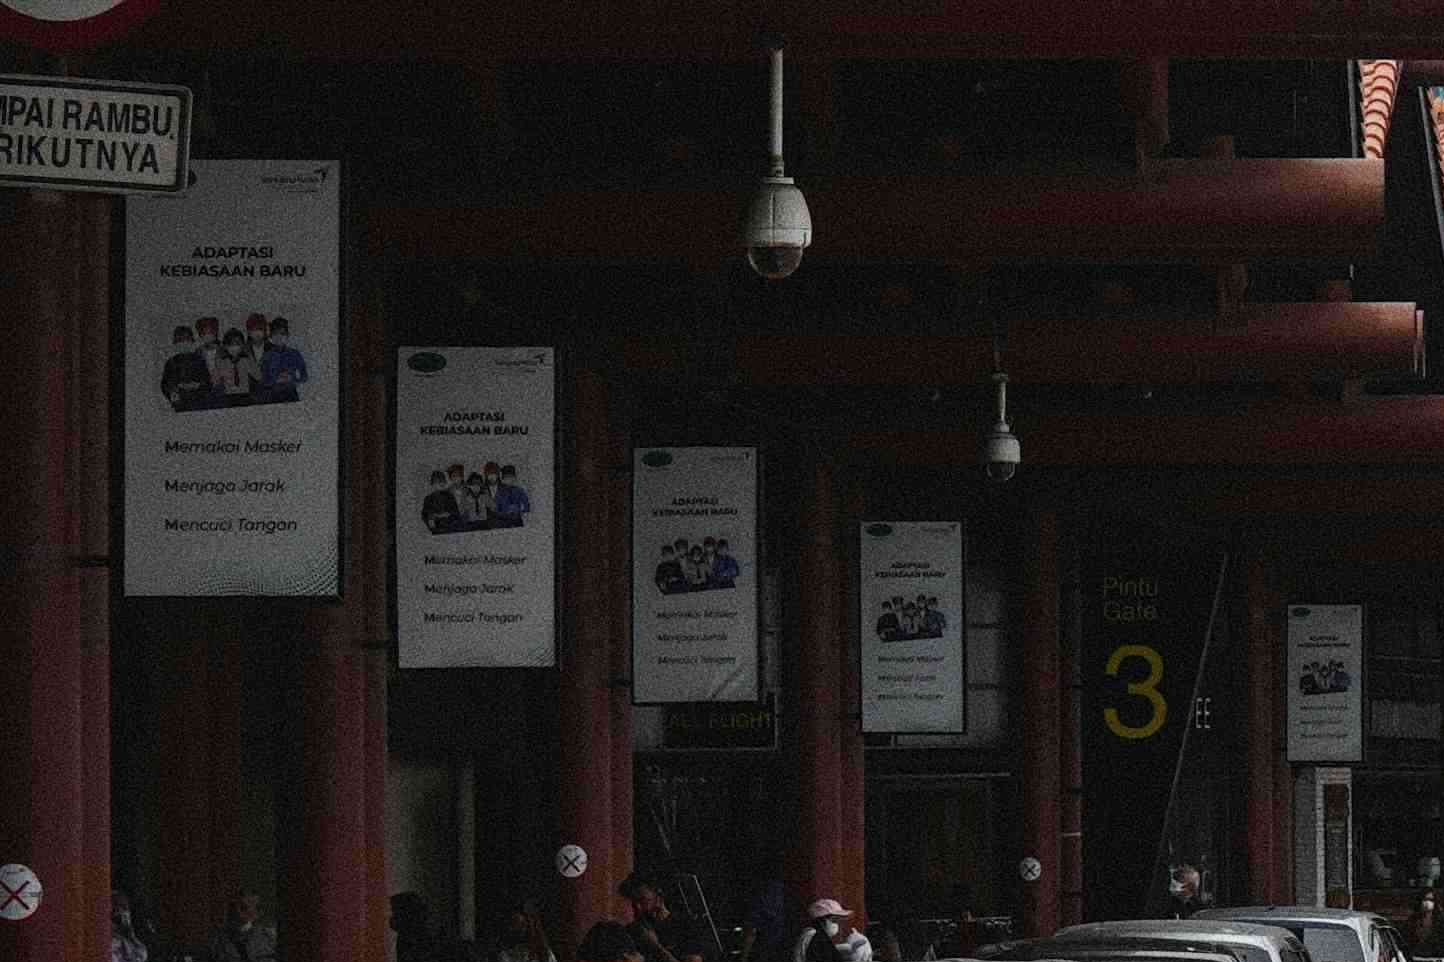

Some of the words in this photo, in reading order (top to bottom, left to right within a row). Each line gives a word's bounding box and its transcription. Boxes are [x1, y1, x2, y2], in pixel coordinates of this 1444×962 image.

[0, 96, 54, 129] PAI
[191, 246, 275, 259] ADAPTASI
[159, 264, 255, 278] KEBIASAAN
[259, 264, 307, 278] BARU
[164, 439, 241, 455] Memakai
[243, 439, 303, 455] Masker
[164, 479, 237, 497] Menjaga
[239, 479, 286, 494] Jarak
[164, 517, 233, 532] Mencuci
[236, 517, 298, 536] Tangan
[1102, 575, 1160, 597] Pintu
[1102, 600, 1158, 622] Gate
[1102, 642, 1169, 740] 3
